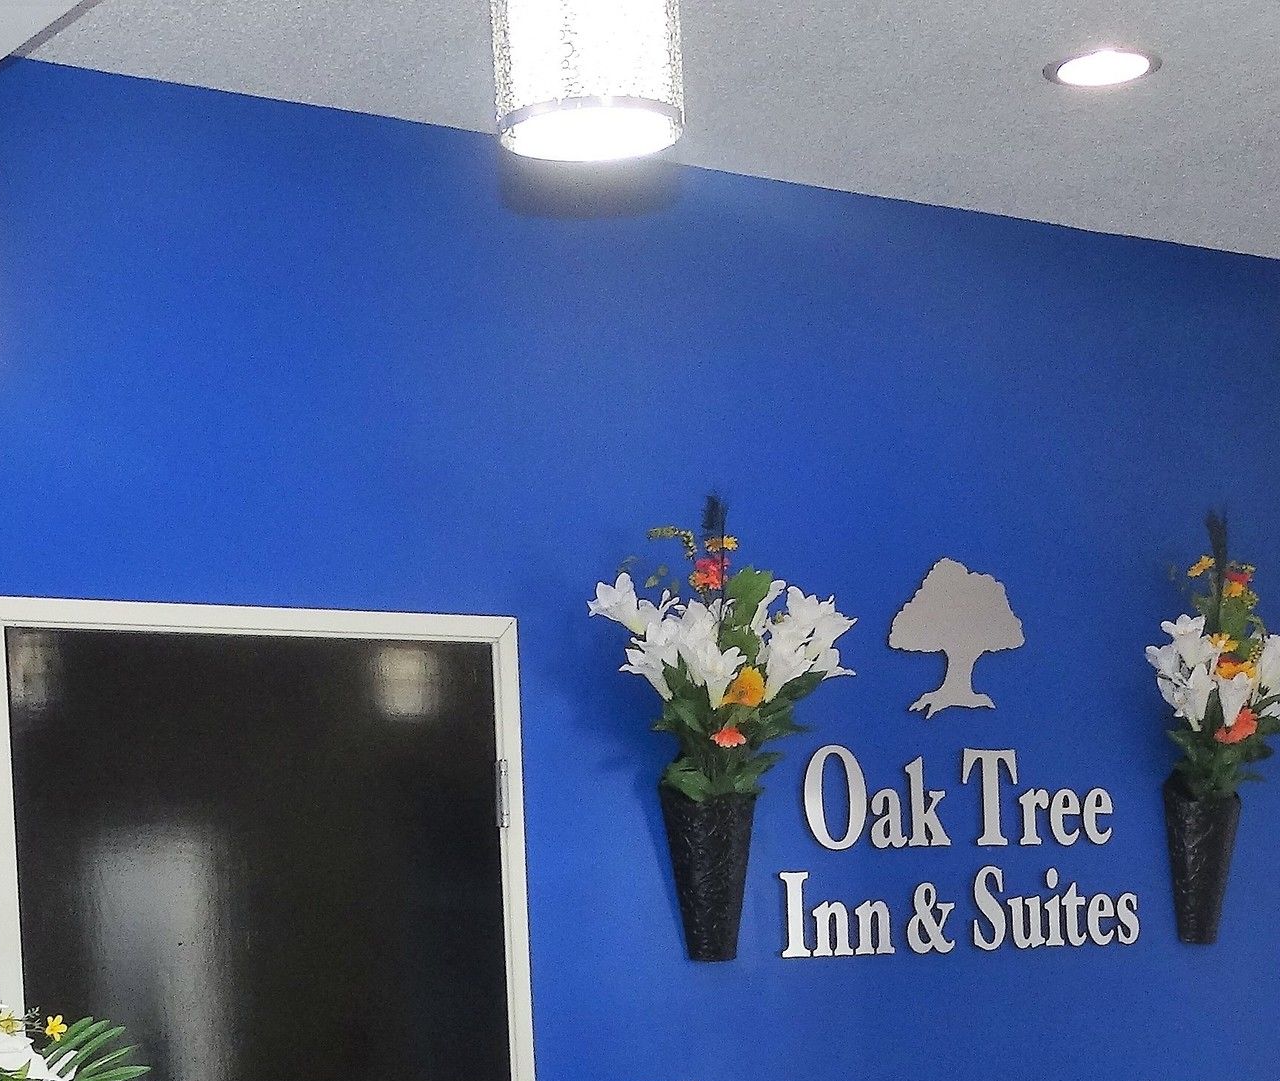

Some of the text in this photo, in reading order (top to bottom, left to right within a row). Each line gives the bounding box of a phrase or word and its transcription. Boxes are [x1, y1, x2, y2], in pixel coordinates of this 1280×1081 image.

[804, 744, 1113, 850] Oak Tree
[779, 866, 1140, 958] Inn & Suites
